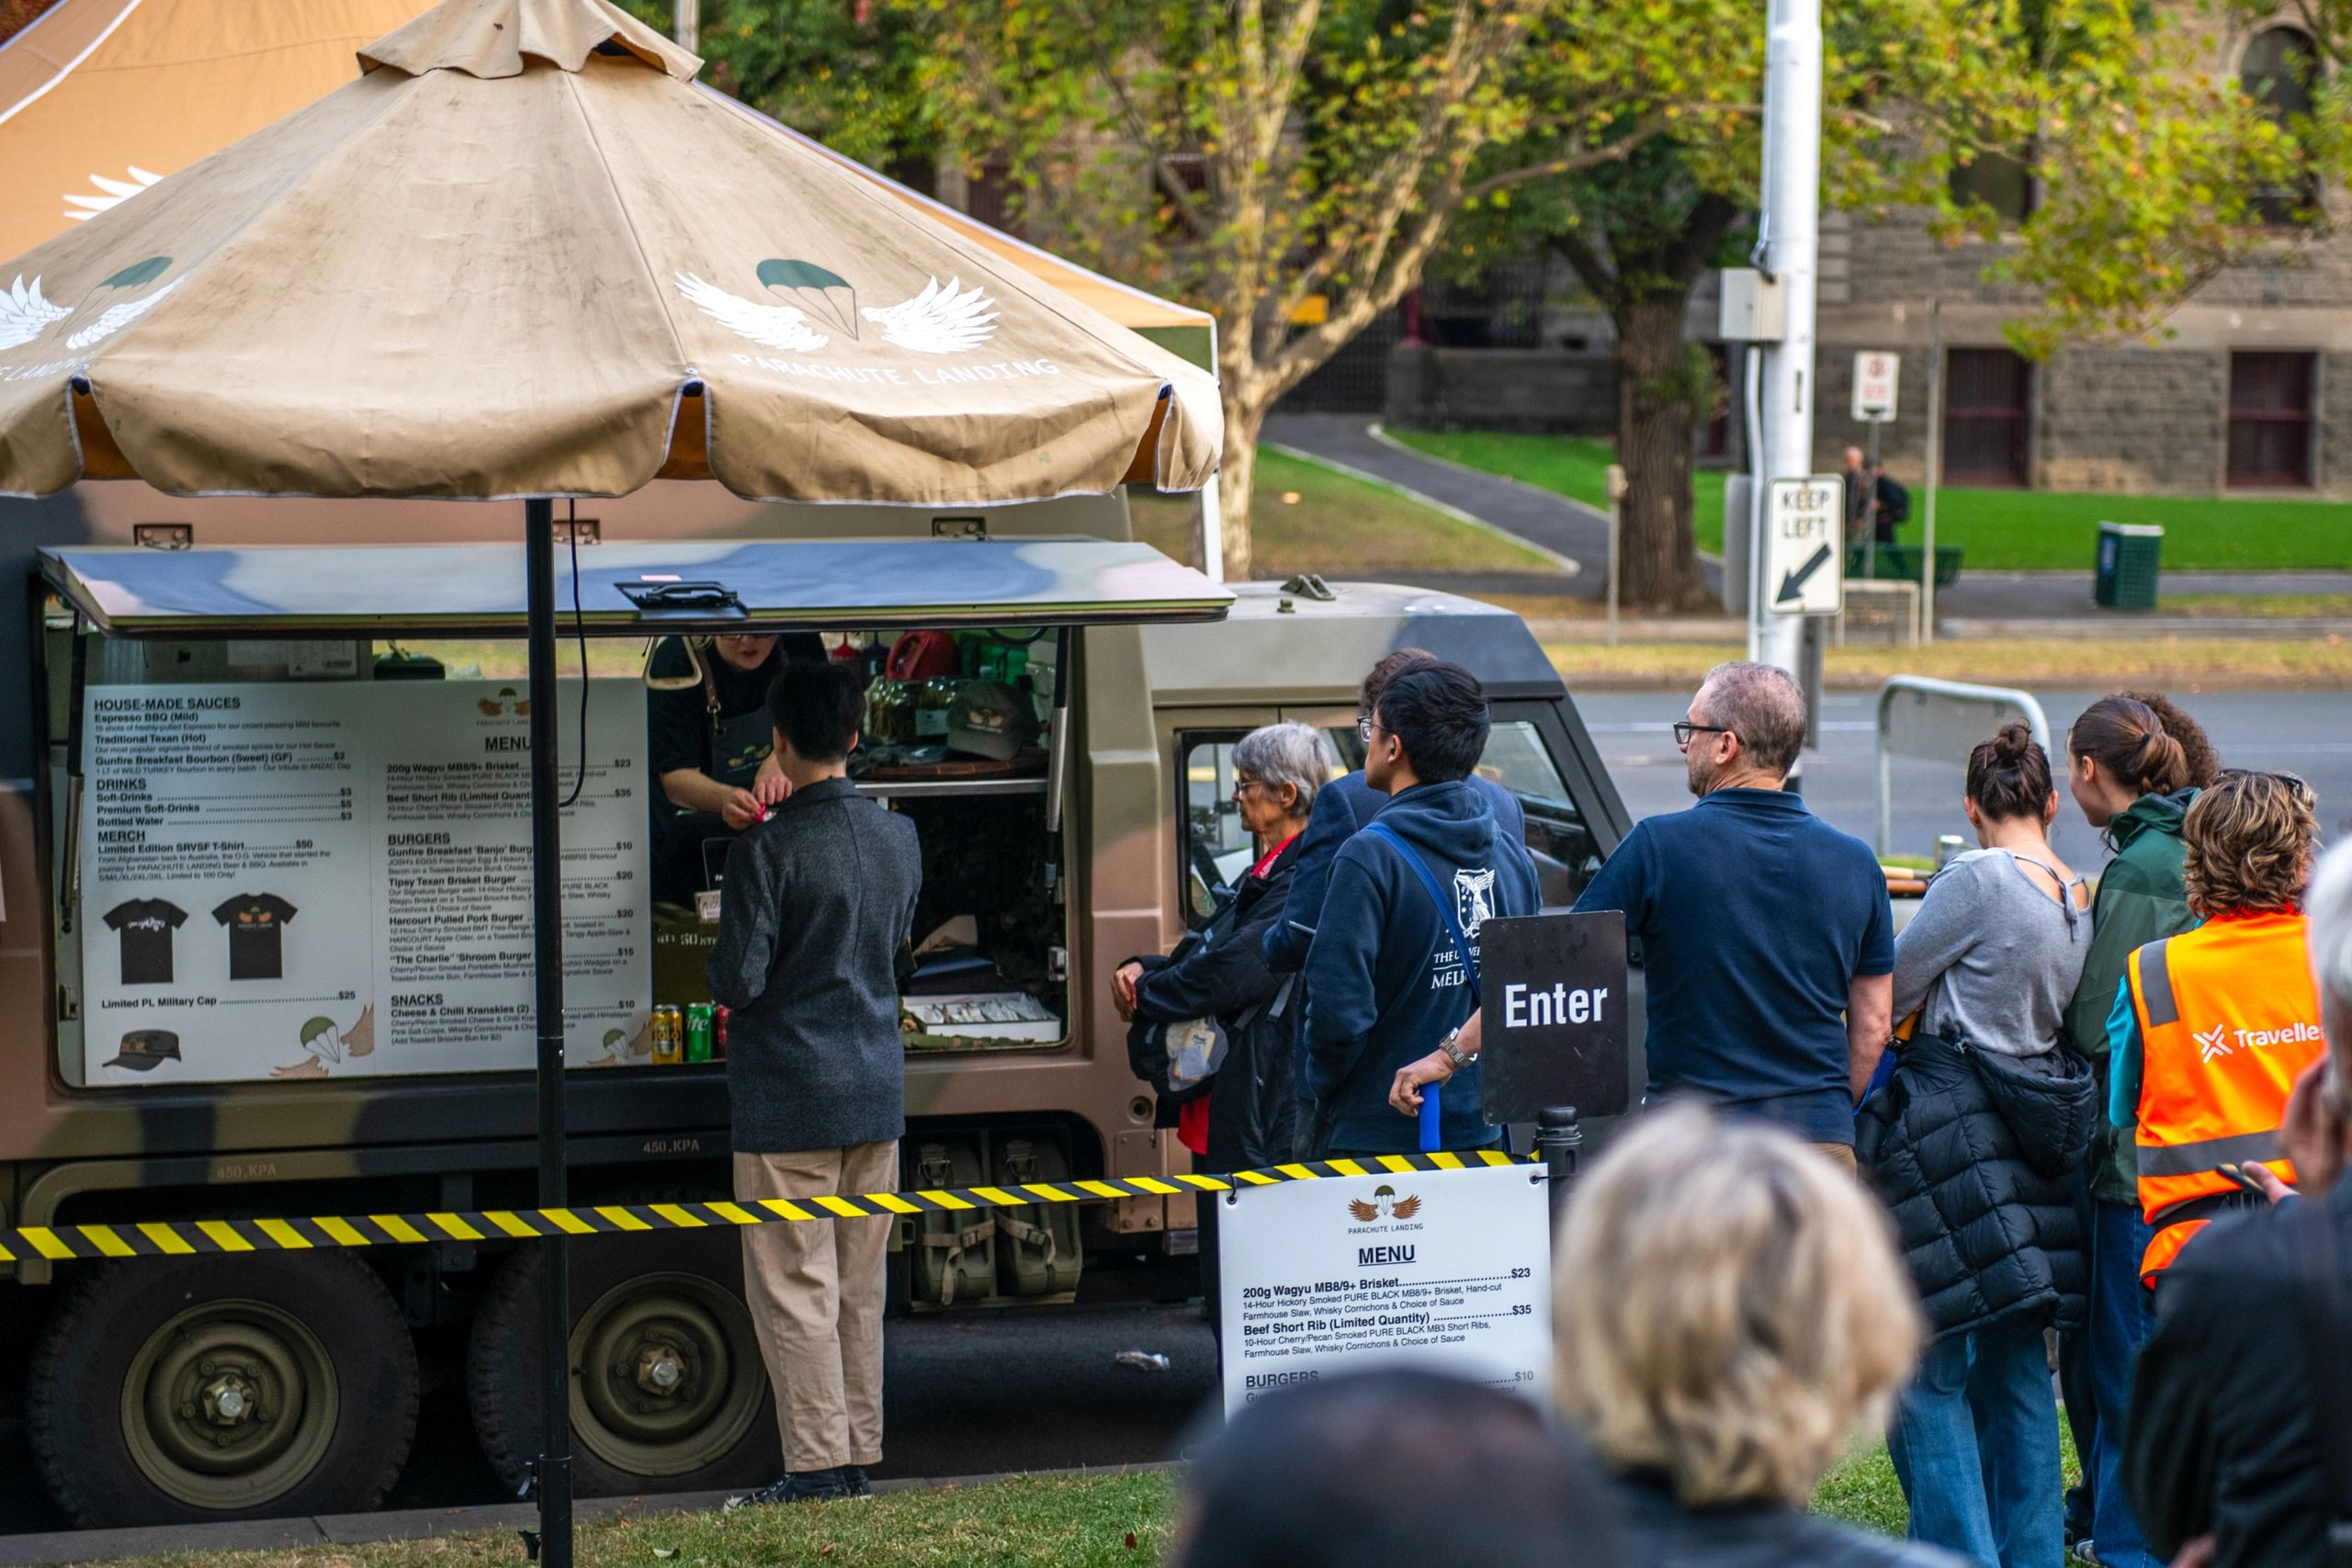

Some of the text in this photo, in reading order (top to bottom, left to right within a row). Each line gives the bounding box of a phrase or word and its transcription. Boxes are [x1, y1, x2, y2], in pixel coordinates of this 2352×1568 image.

[732, 353, 1059, 386] PARACHUTE LANDING
[1781, 490, 1830, 511] KEEP
[1781, 517, 1828, 539] LEFT
[95, 696, 241, 711] HOUSE-MADE SAUCES
[95, 712, 198, 723] Espresso BBQ (Mild)
[95, 733, 206, 744] Traditional Texan (Hot)
[96, 750, 345, 765] Gunfire Breakfast Bourbon (Sweet) (GF) $2
[387, 763, 411, 774] 200g
[412, 762, 445, 774] Wagyu
[485, 761, 519, 771] Brisket
[615, 759, 631, 768] $23
[96, 778, 147, 791] DRINKS
[96, 793, 153, 803] Soft-Drinks
[387, 787, 631, 803] Beef Short Rib (Limited Quant $35
[96, 806, 141, 815] Premium
[144, 804, 200, 814] Soft-Drinks
[97, 818, 133, 827] Bottled
[135, 818, 164, 826] Water
[97, 830, 146, 843] MERCH
[388, 832, 450, 846] BURGERS
[97, 845, 135, 854] Limited
[138, 843, 174, 853] Edition
[212, 840, 244, 851] T-Shirt
[295, 840, 313, 850] $50
[388, 847, 424, 857] Gunfire
[426, 845, 471, 855] Breakfast
[509, 844, 533, 854] Burg
[616, 840, 632, 851] $10
[389, 871, 633, 887] Tipsy Texan Brisket Burger $20
[390, 908, 634, 926] Harcourt Pulled Pork Burger $20
[499, 951, 531, 962] Burger
[617, 947, 634, 956] $15
[1433, 951, 1454, 964] THE
[102, 990, 356, 1010] Limited PL Military Cap $25
[390, 993, 444, 1007] SNACKS
[1505, 982, 1608, 1028] Enter
[390, 999, 635, 1018] Cheese & Chilli Kranskies (2) $10
[2233, 1022, 2327, 1048] Travelle
[1348, 1223, 1424, 1235] PARACHUTE LANDING
[1359, 1245, 1415, 1265] MENU
[1243, 1268, 1531, 1299] 200g Wagyu MB8/9+ Brisket $23
[1243, 1283, 1502, 1309] 14-Hour Hickory Smoked PURE BLACK MB8/9+ Brisket, Hand-cut
[1243, 1296, 1464, 1321] Farmhouse Slaw, Whisky Cornichons & Choice of Sauce
[1244, 1304, 1532, 1336] Beef Short Rib (Limited Quantity) $35
[1244, 1321, 1491, 1347] 10-Hour Cherry/Pecan Smoked PURE BLACK MB3 Short Ribs,
[1245, 1334, 1465, 1358] Farmhouse Slaw, Whisky Cornichons & Choice of Sauce
[1246, 1370, 1533, 1388] BURGERS $10
